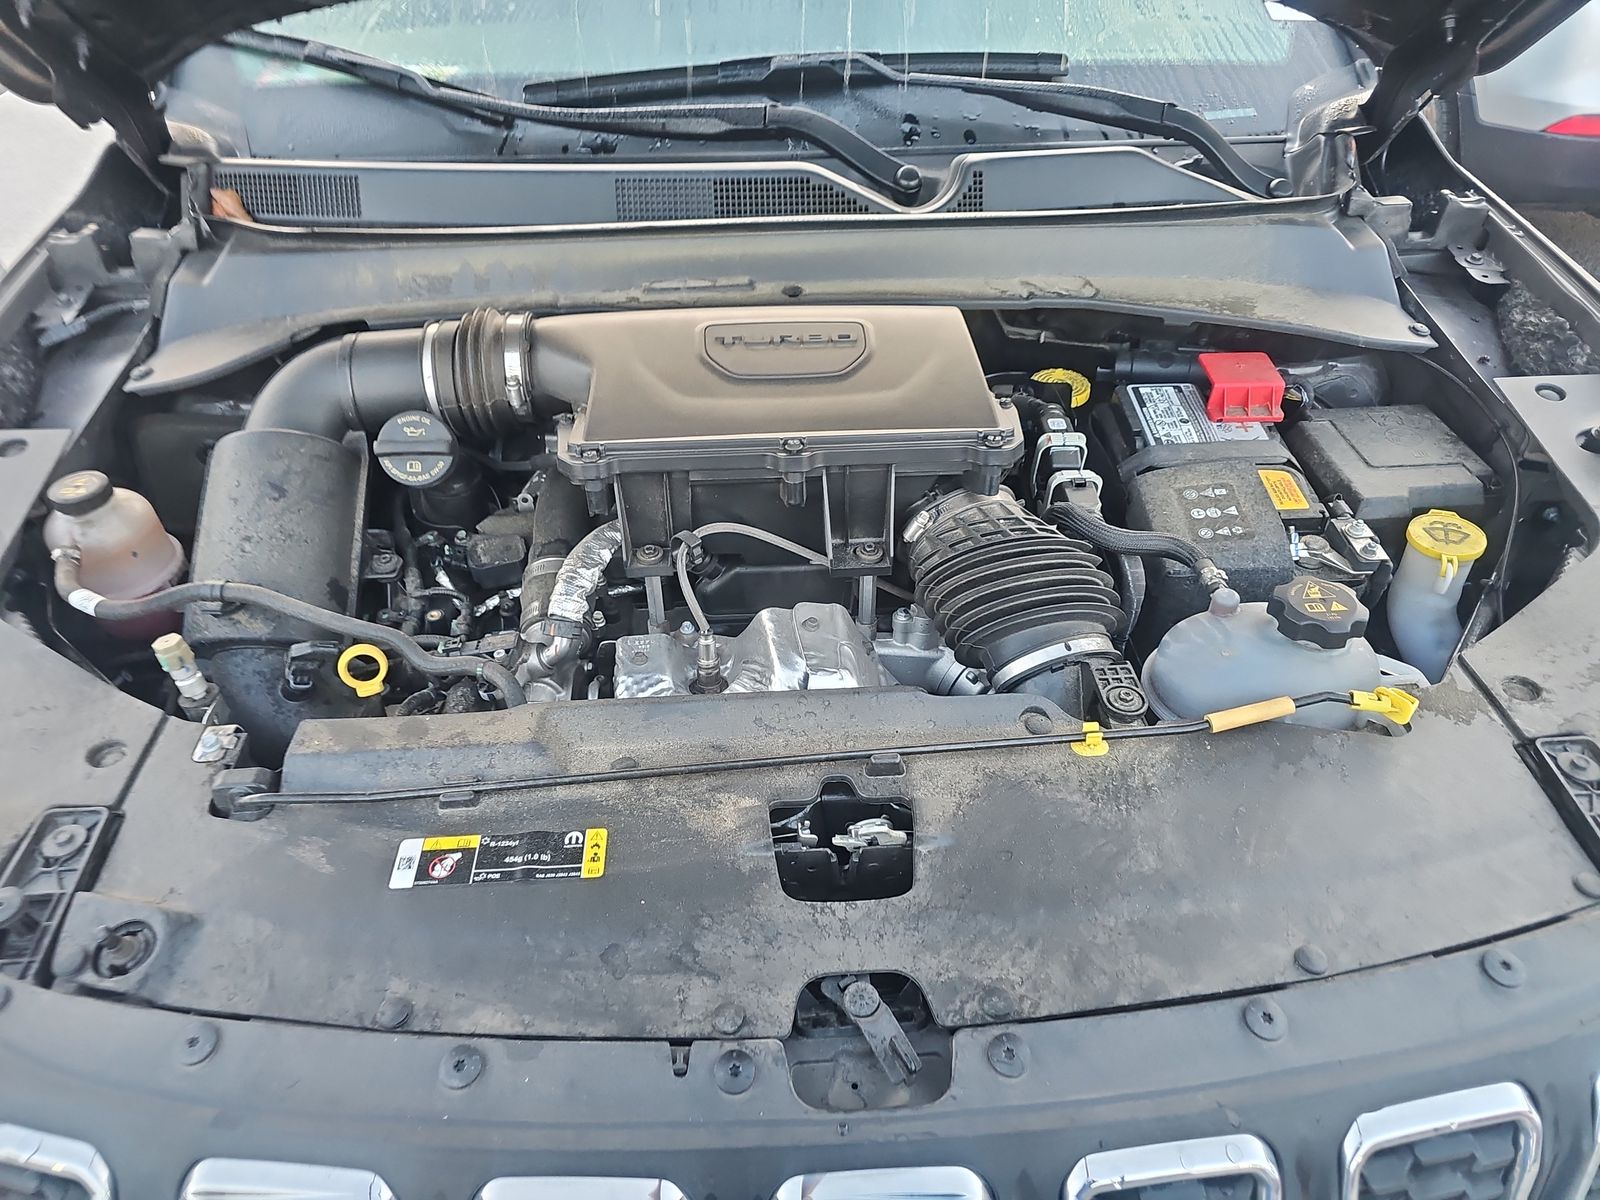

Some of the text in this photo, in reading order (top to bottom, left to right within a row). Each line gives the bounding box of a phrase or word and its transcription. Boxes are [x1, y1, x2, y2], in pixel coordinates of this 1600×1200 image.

[714, 333, 858, 348] TURBO
[397, 415, 431, 425] ENGINE OIL
[489, 839, 519, 847] R-1234yf
[503, 853, 551, 863] 454g (1.0 lb)
